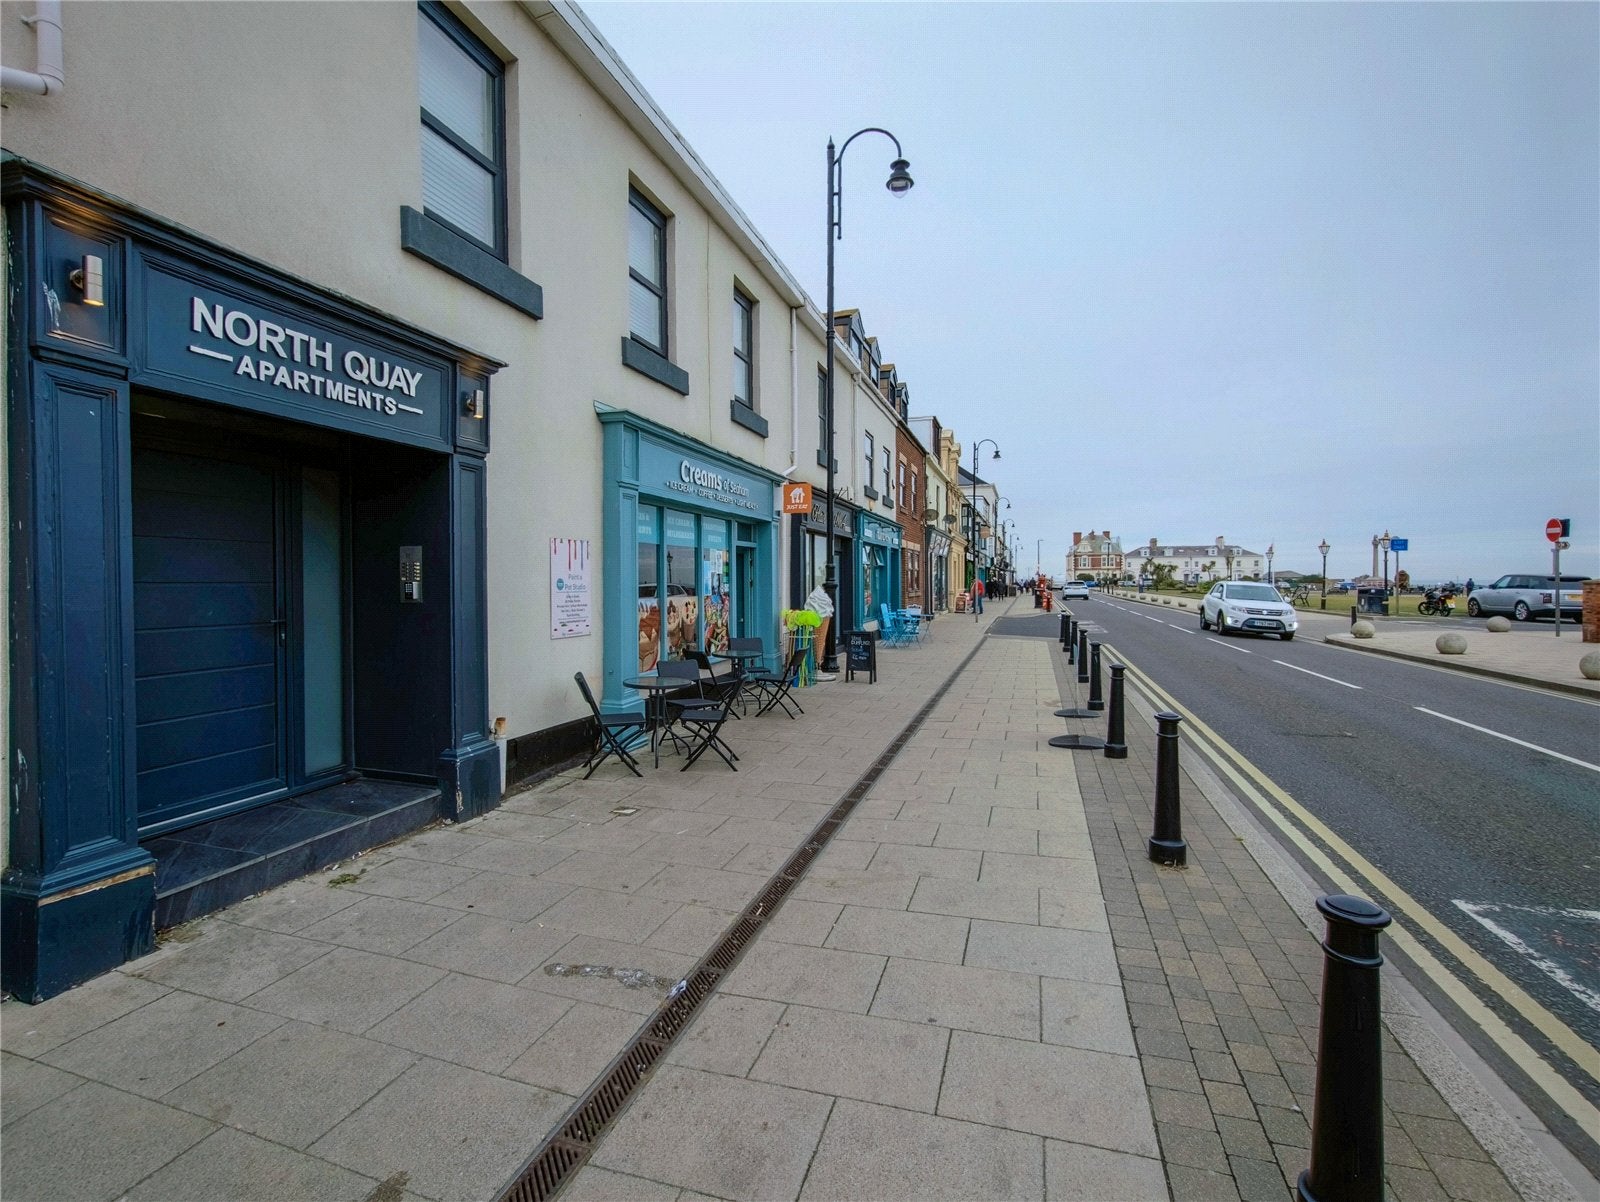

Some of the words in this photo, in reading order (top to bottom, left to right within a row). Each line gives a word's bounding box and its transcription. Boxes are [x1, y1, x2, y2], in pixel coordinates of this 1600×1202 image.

[191, 296, 333, 372] NORTH
[343, 350, 423, 397] QUAY
[235, 355, 398, 415] APARTMENTS
[680, 459, 722, 491] Creams
